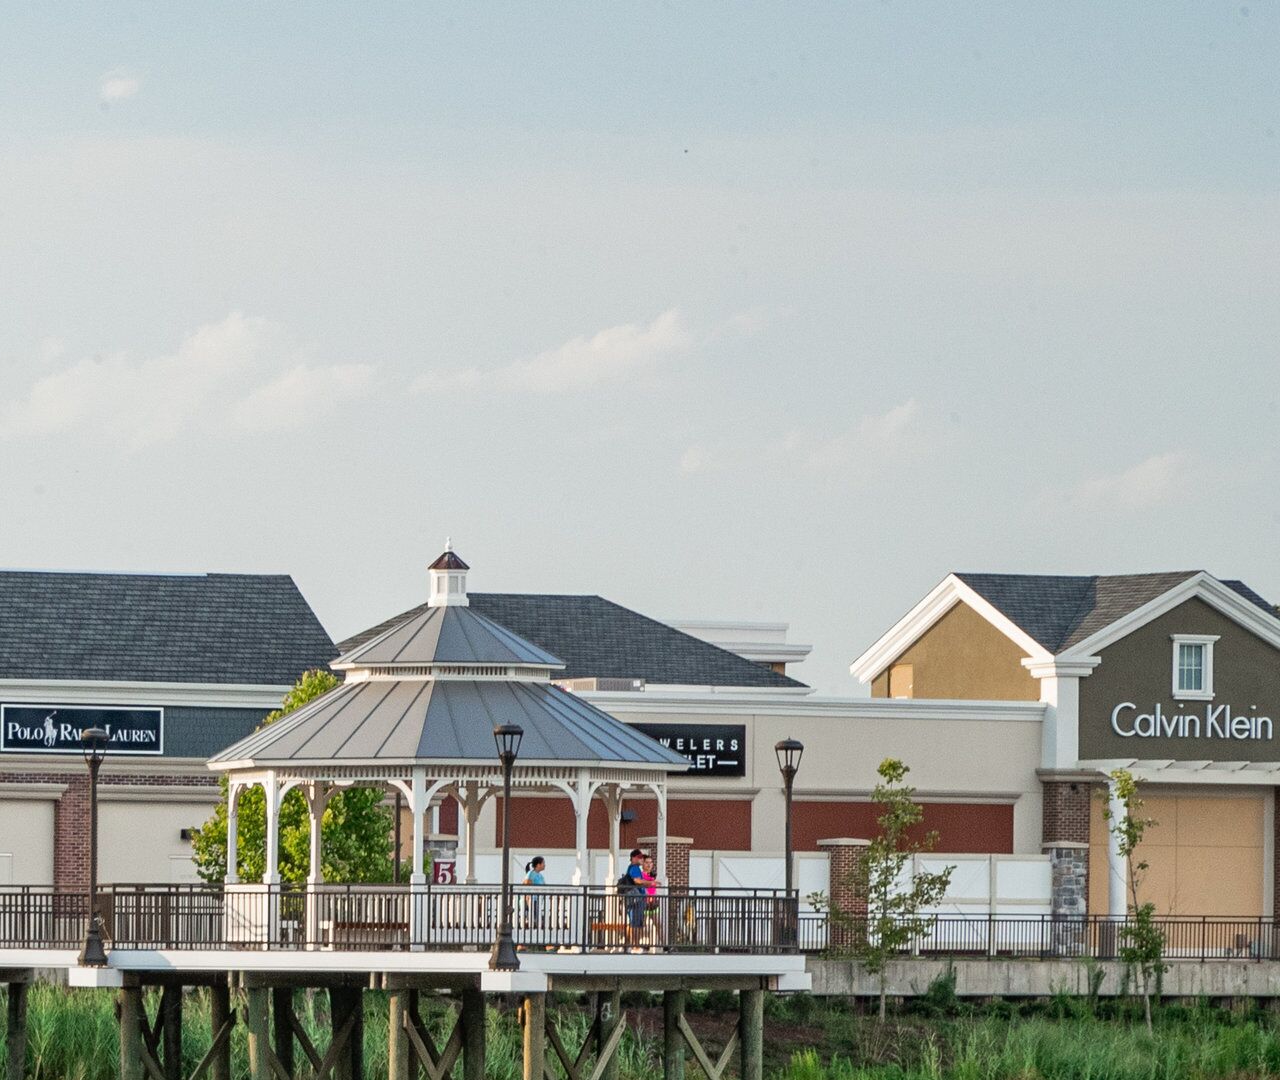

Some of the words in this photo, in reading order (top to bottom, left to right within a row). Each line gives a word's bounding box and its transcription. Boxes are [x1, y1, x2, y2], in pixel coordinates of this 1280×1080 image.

[1111, 702, 1201, 738] Calvin
[1206, 704, 1273, 740] Klein
[659, 738, 739, 751] WELERS
